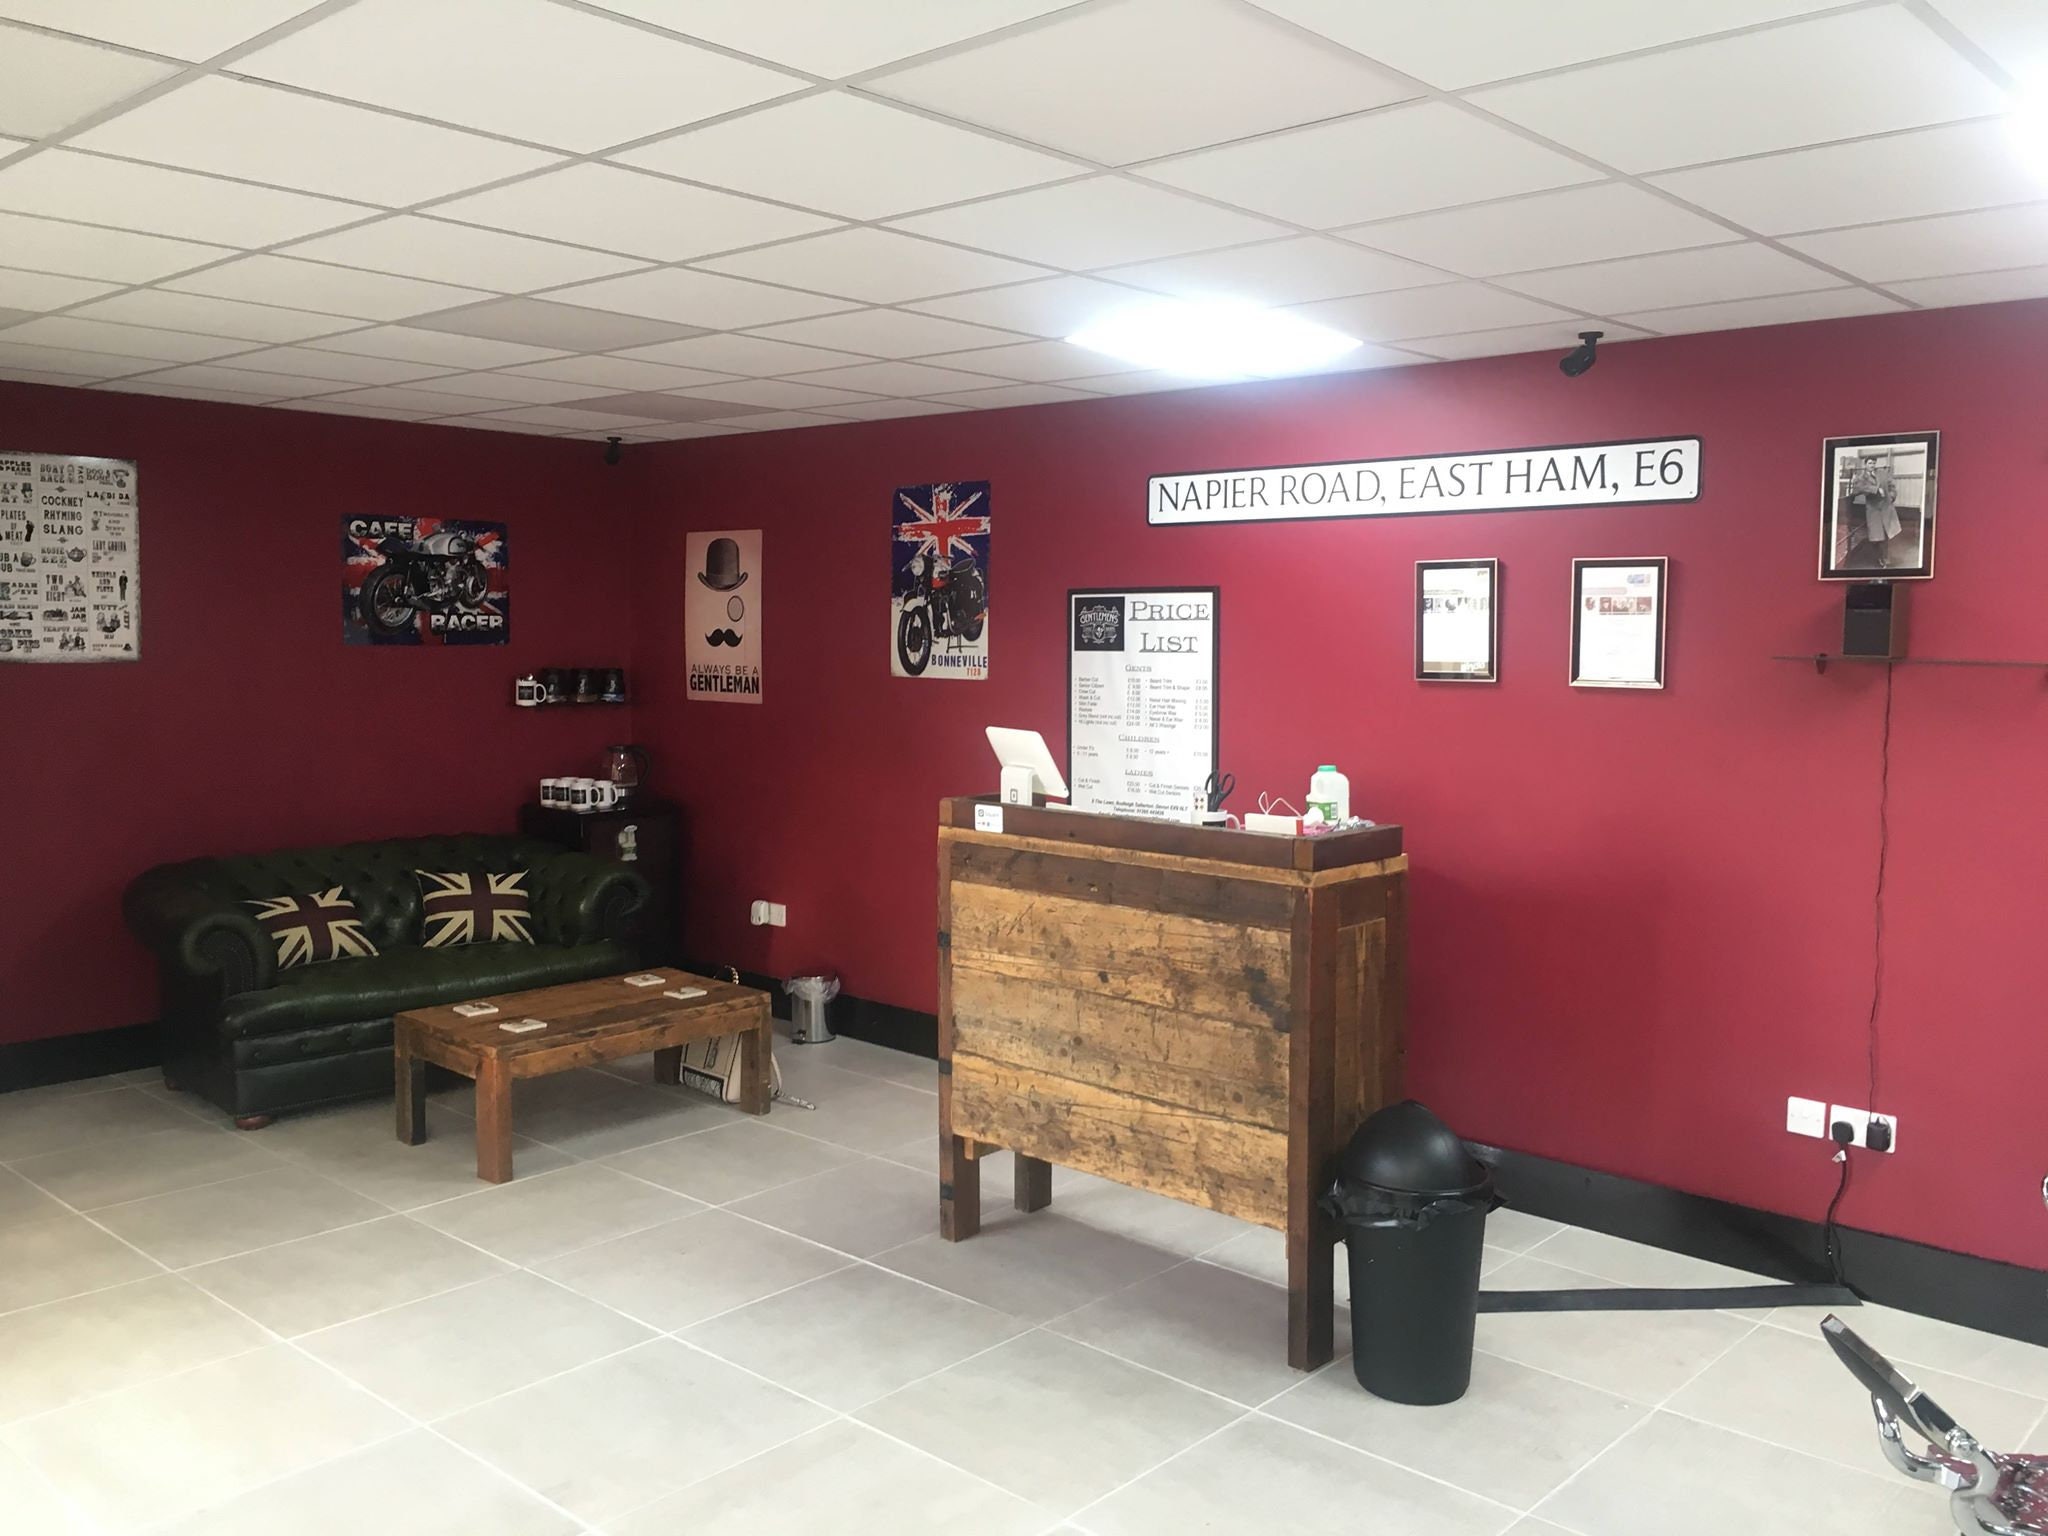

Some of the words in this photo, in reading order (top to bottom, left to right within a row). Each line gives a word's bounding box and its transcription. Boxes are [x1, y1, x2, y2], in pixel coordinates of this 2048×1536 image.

[1158, 476, 1269, 512] NAPIER
[1280, 469, 1386, 506] ROAD,
[1400, 460, 1493, 500] EAST
[1505, 453, 1620, 496] HAM,
[1634, 448, 1684, 487] E6
[41, 495, 84, 507] COCKNEY
[1, 510, 26, 520] PLATES
[44, 509, 82, 521] RHYMING
[5, 531, 23, 541] MEAT
[43, 524, 84, 536] SLANG
[350, 519, 413, 539] CAFE
[1128, 601, 1210, 622] PRICE
[430, 614, 503, 632] RACER
[1138, 632, 1198, 653] LIST
[931, 654, 988, 668] BONNEVILLE
[691, 663, 731, 675] ALWAYS
[735, 665, 748, 675] BE
[752, 666, 759, 675] A
[690, 673, 760, 694] GENTLEMAN
